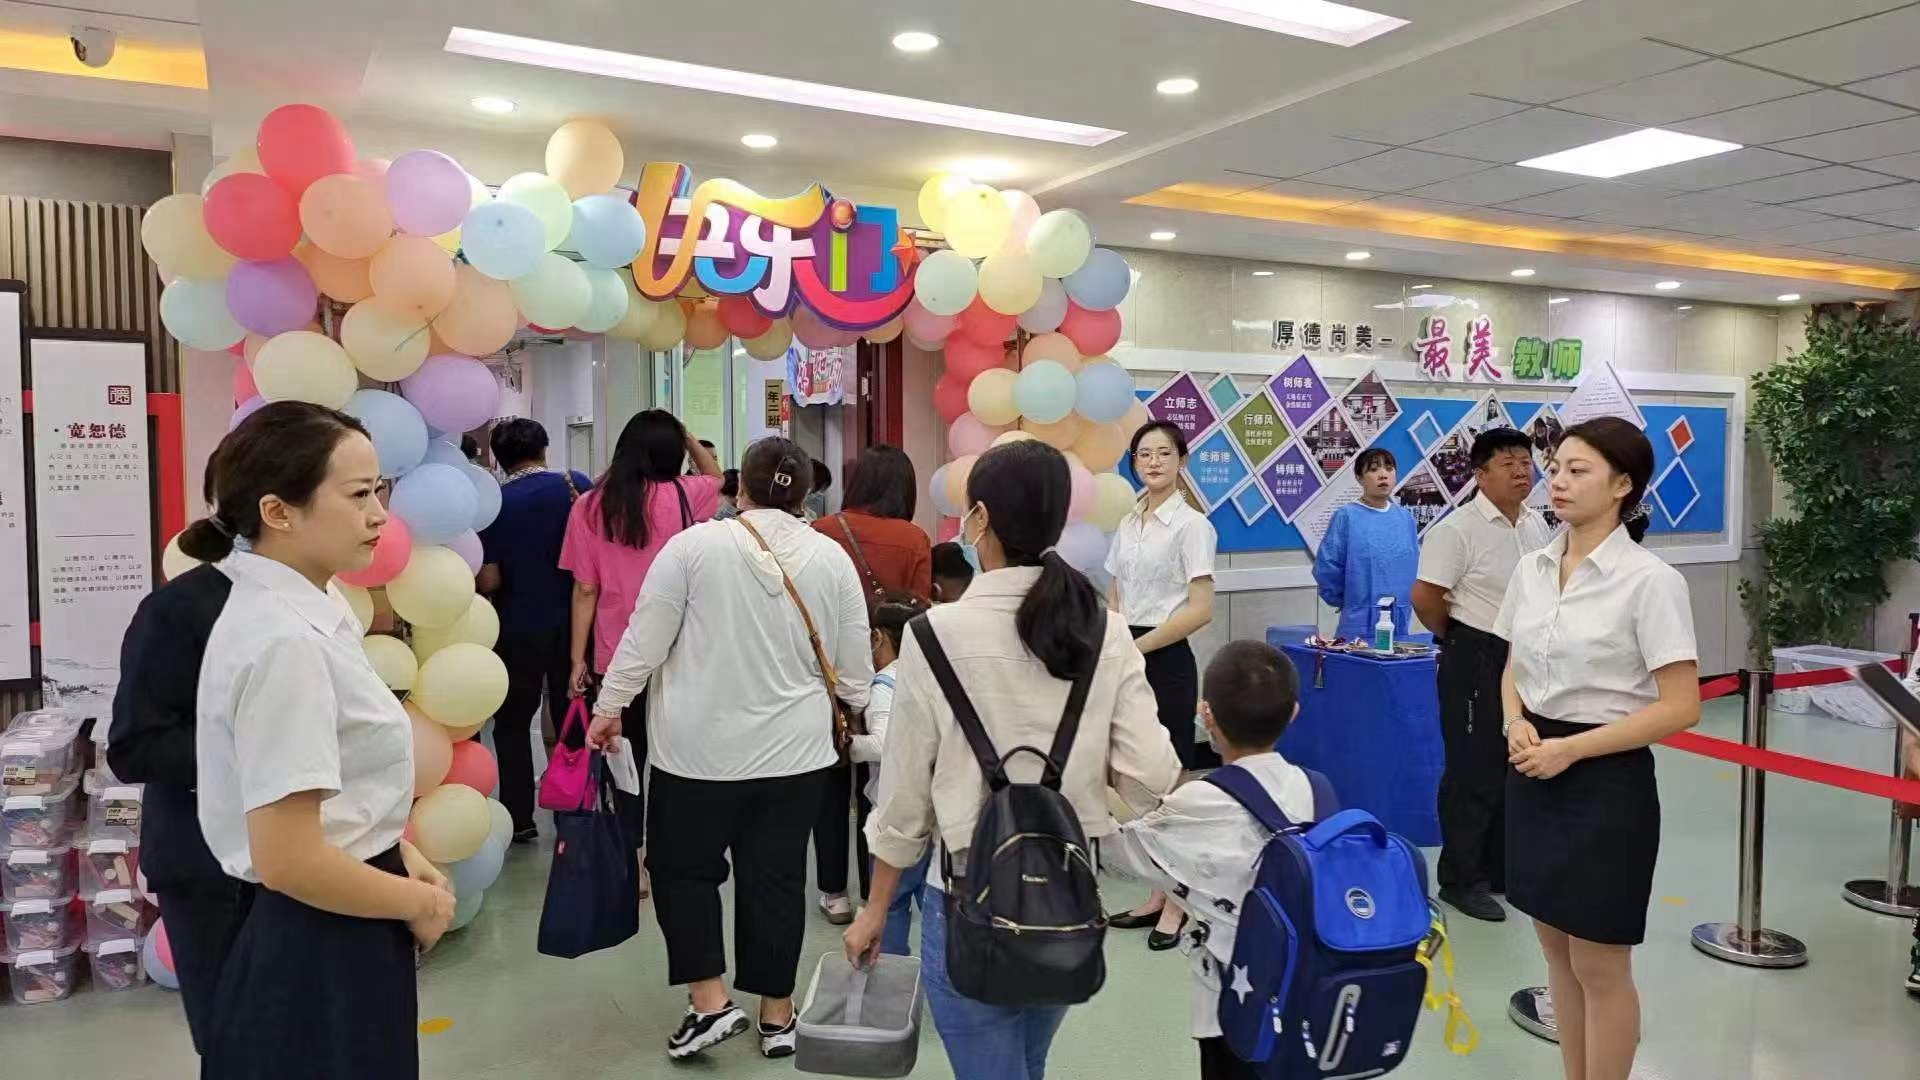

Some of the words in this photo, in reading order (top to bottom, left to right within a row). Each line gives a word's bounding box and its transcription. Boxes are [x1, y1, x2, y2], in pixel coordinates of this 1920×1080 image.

[1416, 317, 1583, 380] 最美教师
[1283, 376, 1313, 389] 树师表
[767, 384, 781, 427] 一年二班
[1164, 396, 1197, 409] 立师志
[1244, 413, 1273, 426] 行师风
[1275, 463, 1305, 476] 铸师魂
